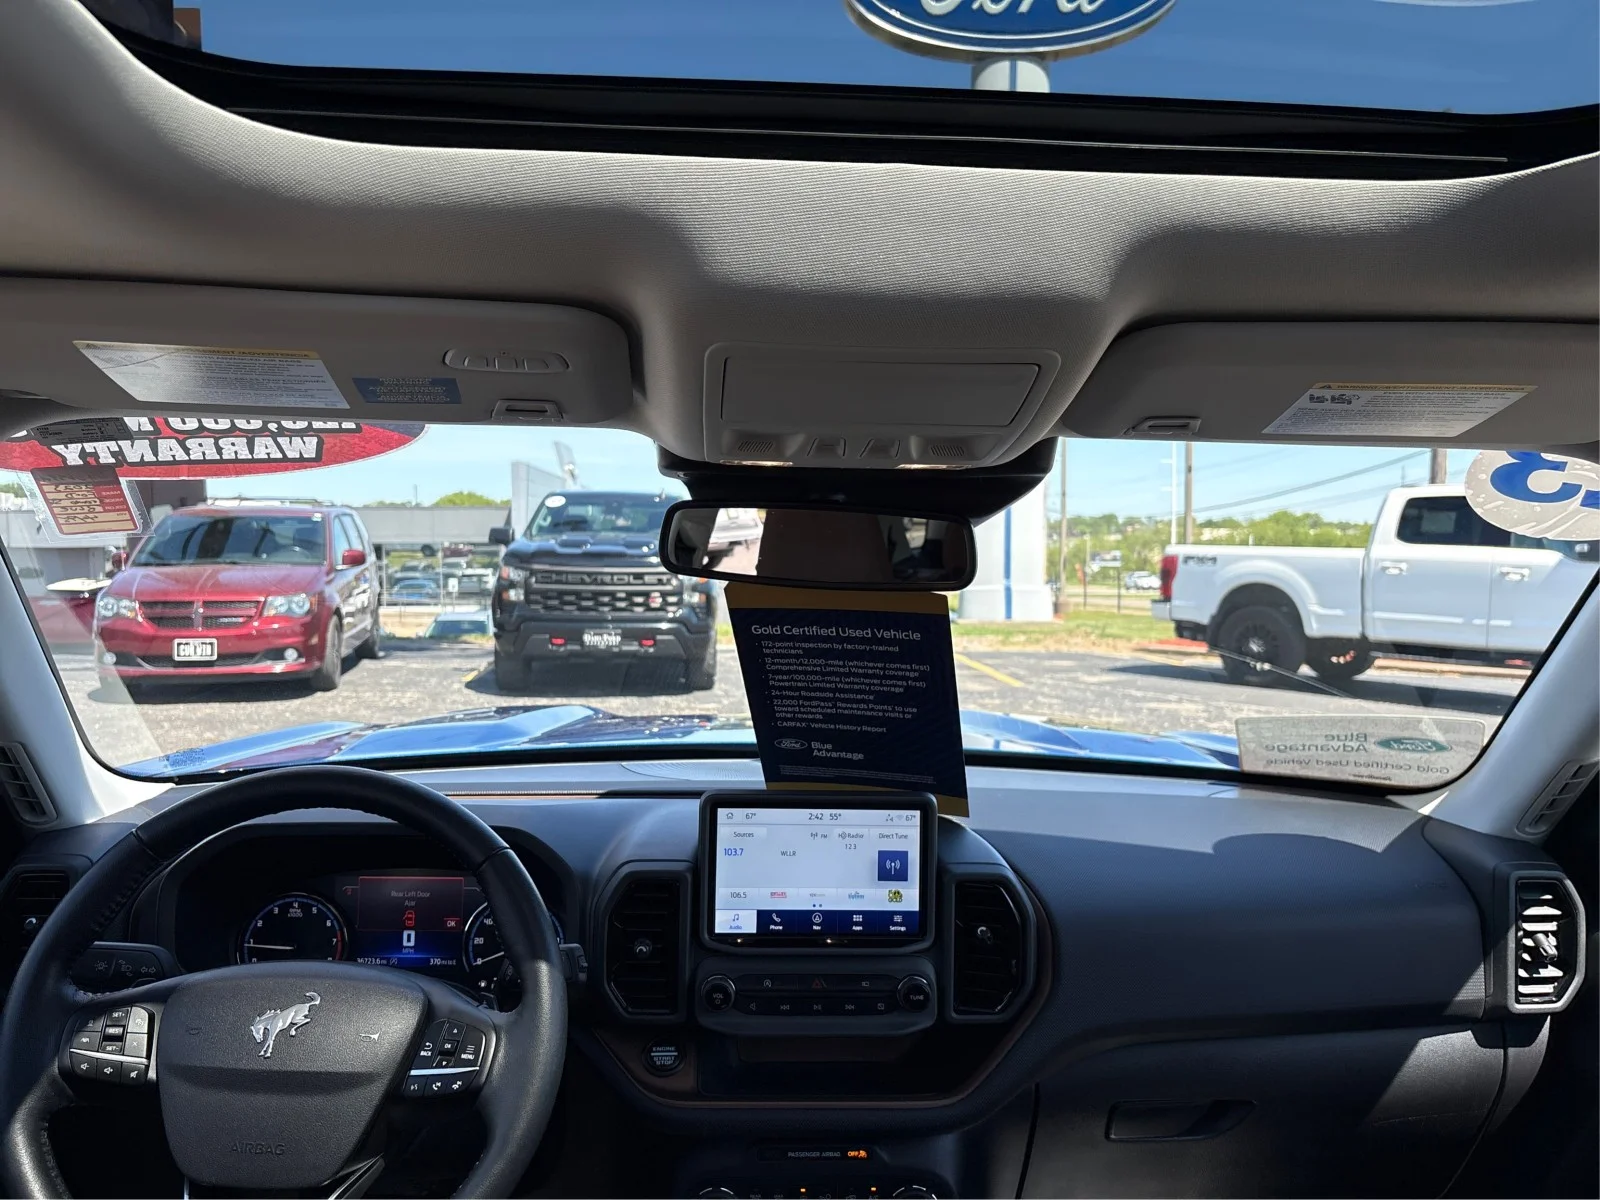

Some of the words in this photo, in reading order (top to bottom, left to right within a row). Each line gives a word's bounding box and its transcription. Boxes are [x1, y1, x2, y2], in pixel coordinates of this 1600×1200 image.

[535, 572, 671, 585] CHEVROLET
[751, 624, 781, 635] Gold
[783, 625, 837, 636] Certified
[839, 626, 872, 637] Used
[873, 628, 921, 640] Vehicle
[761, 640, 794, 648] 172-point
[795, 641, 832, 650] inspection
[833, 642, 842, 650] by
[843, 642, 899, 652] factory-trained
[765, 664, 821, 672] Comprehensive
[822, 665, 849, 673] Limited
[850, 666, 884, 676] Warranty
[845, 659, 884, 668] (whichever
[912, 664, 930, 672] first)
[769, 680, 808, 688] Powertrain
[836, 682, 870, 691] Warranty
[842, 676, 881, 685] (whichever
[908, 680, 927, 688] first)
[800, 690, 834, 698] Roadside
[836, 701, 868, 709] Rewards
[774, 705, 799, 713] toward
[799, 706, 836, 714] scheduled
[837, 708, 884, 717] maintenance
[884, 711, 904, 719] visits
[835, 723, 861, 733] History
[861, 725, 887, 734] Report
[811, 741, 833, 750] Blue
[812, 749, 865, 761] Advantage
[808, 812, 824, 821] 2:42
[723, 847, 744, 857] 103.7
[730, 891, 747, 899] 106.5
[311, 906, 318, 914] 5
[257, 919, 264, 927] 2
[325, 919, 332, 927] 6
[331, 937, 338, 946] 7
[402, 929, 416, 947] 0
[473, 937, 484, 945] 20
[429, 958, 441, 966] 370
[231, 1141, 286, 1157] AIRBAG
[847, 1150, 859, 1158] OFF
